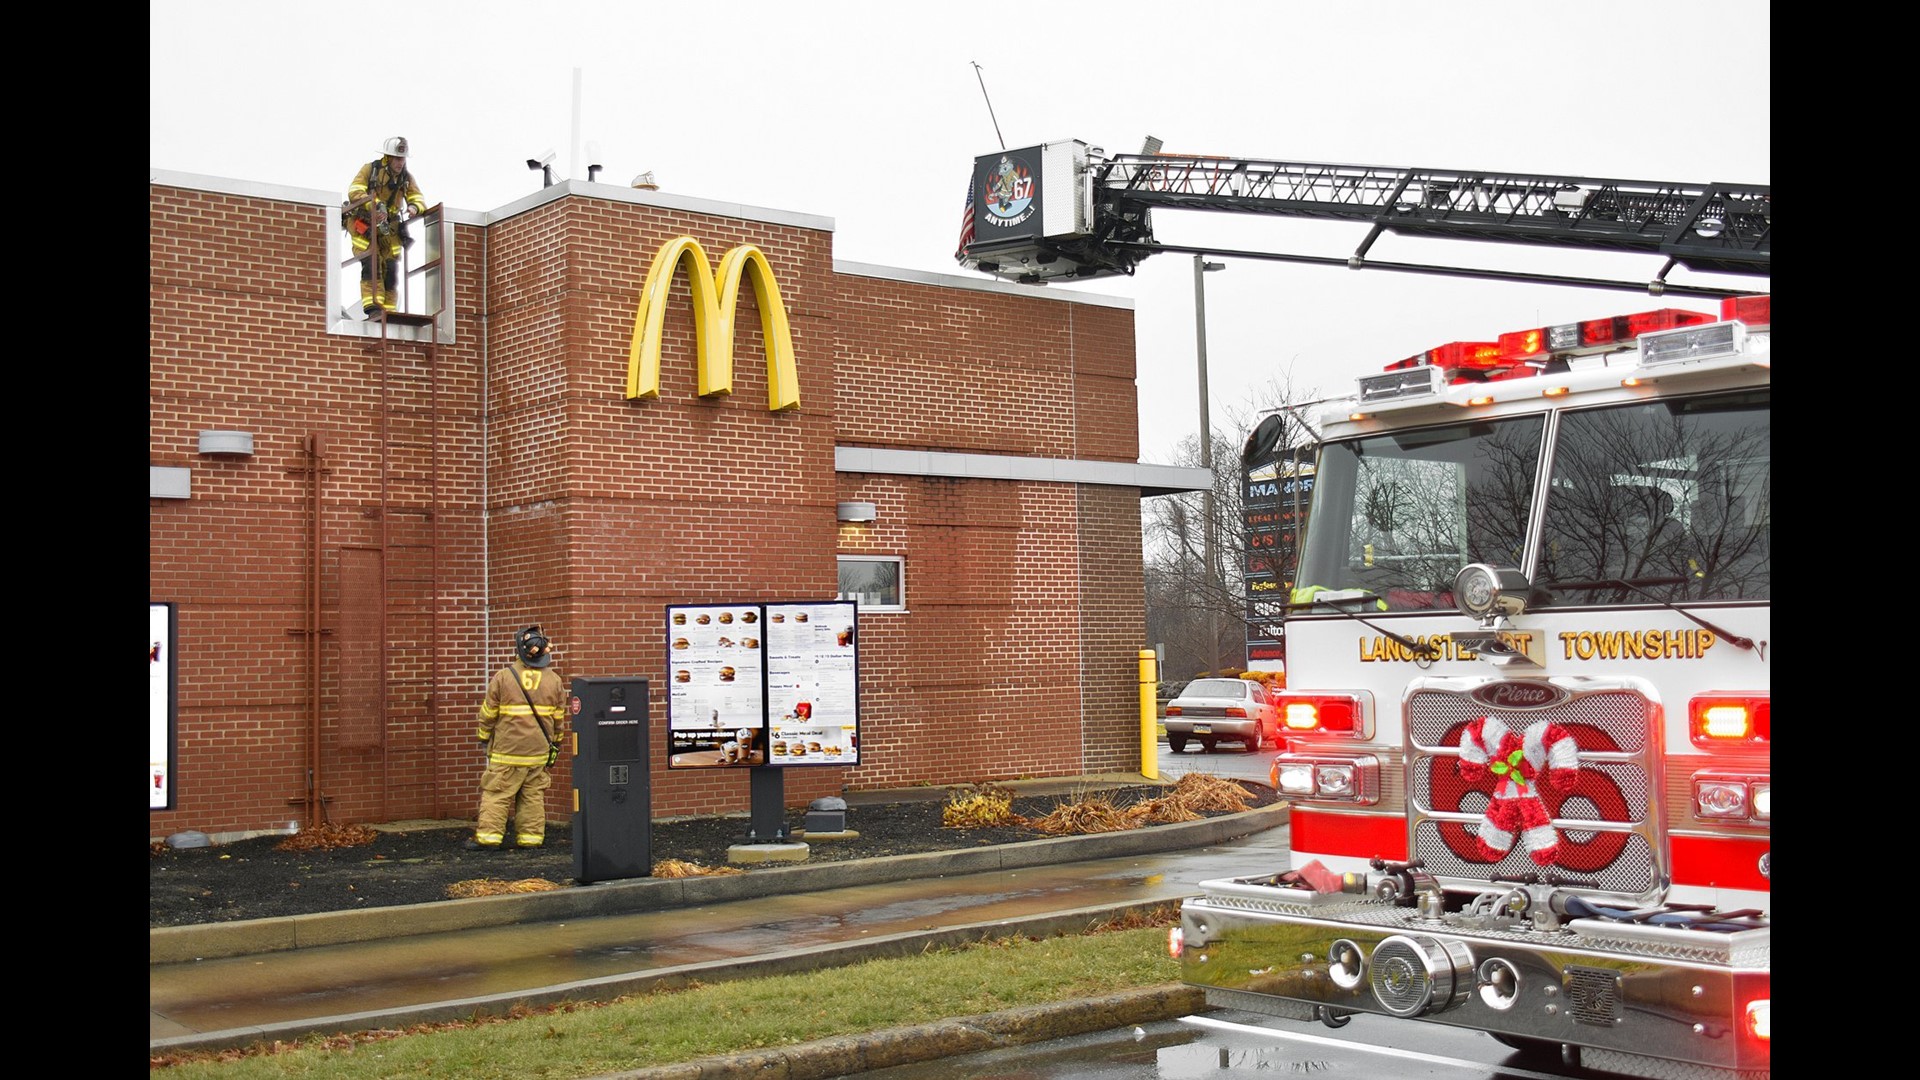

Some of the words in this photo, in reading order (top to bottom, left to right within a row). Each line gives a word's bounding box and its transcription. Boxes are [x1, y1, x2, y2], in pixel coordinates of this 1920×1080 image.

[1013, 177, 1033, 200] 67
[1359, 633, 1481, 663] LANCASTE
[1558, 629, 1716, 661] TOWNSHIP
[521, 669, 543, 690] 67
[1492, 684, 1546, 704] Pierce
